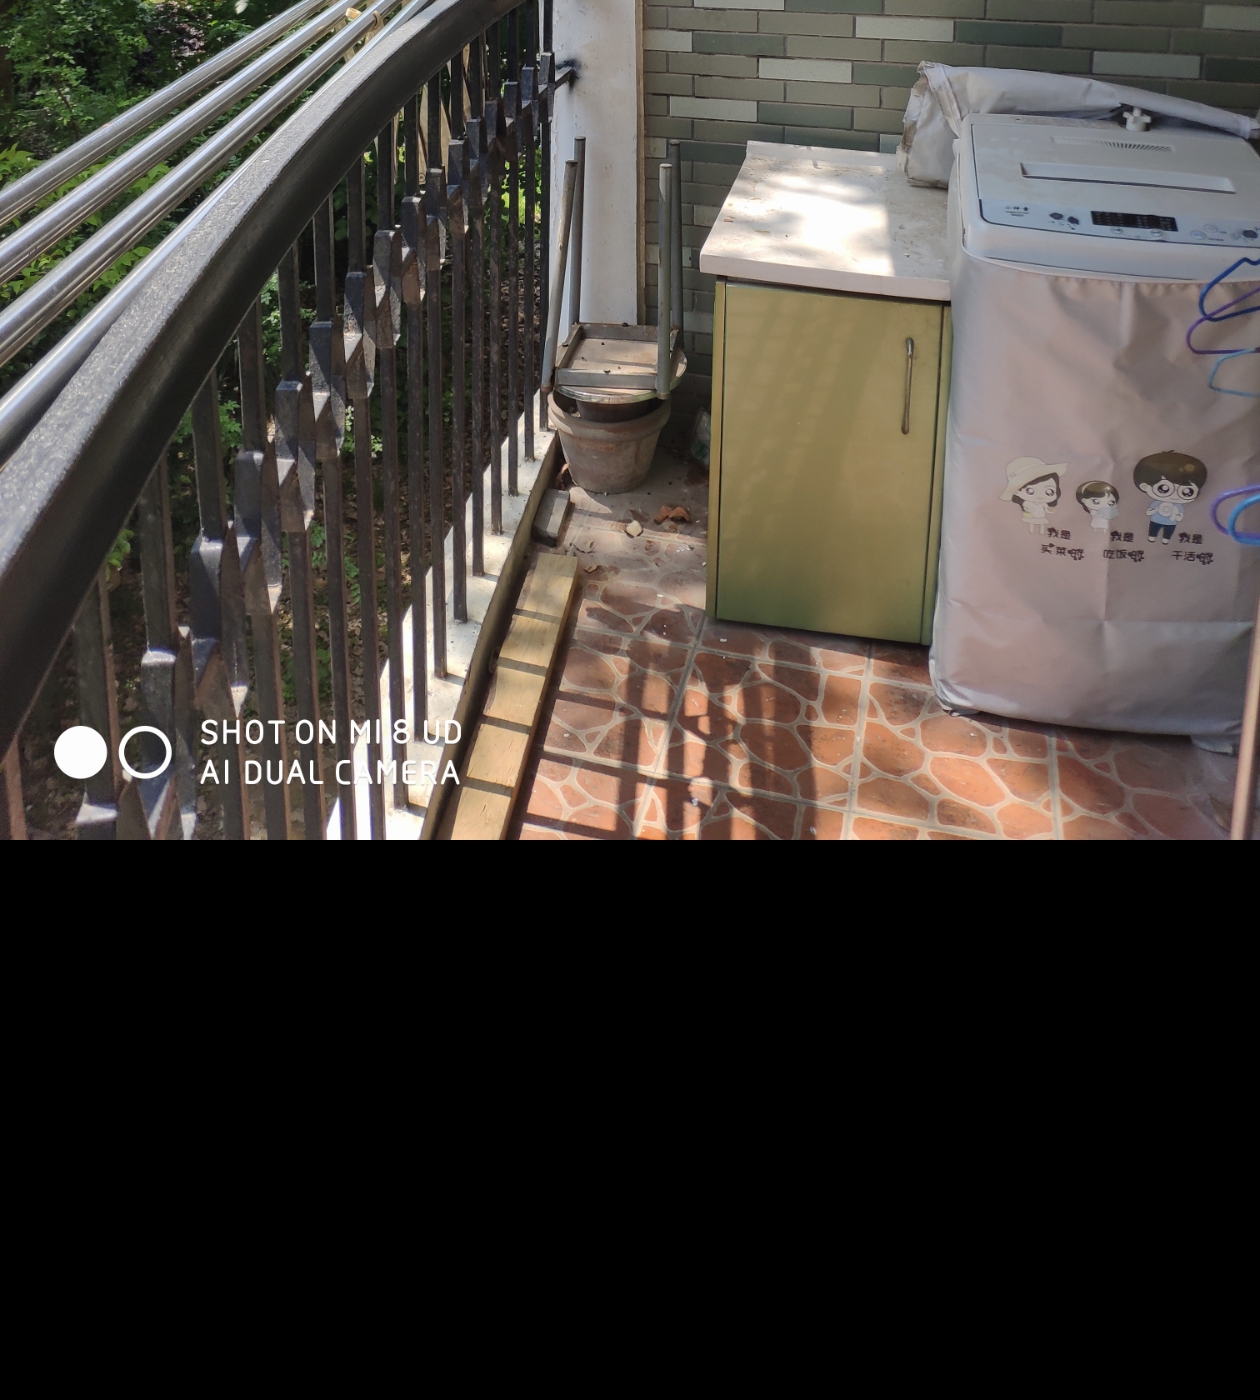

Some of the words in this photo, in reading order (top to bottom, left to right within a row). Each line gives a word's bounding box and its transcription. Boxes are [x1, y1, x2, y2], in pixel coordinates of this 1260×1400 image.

[1047, 527, 1072, 540] 我是
[1110, 530, 1135, 543] 我是
[1178, 532, 1203, 545] 我是
